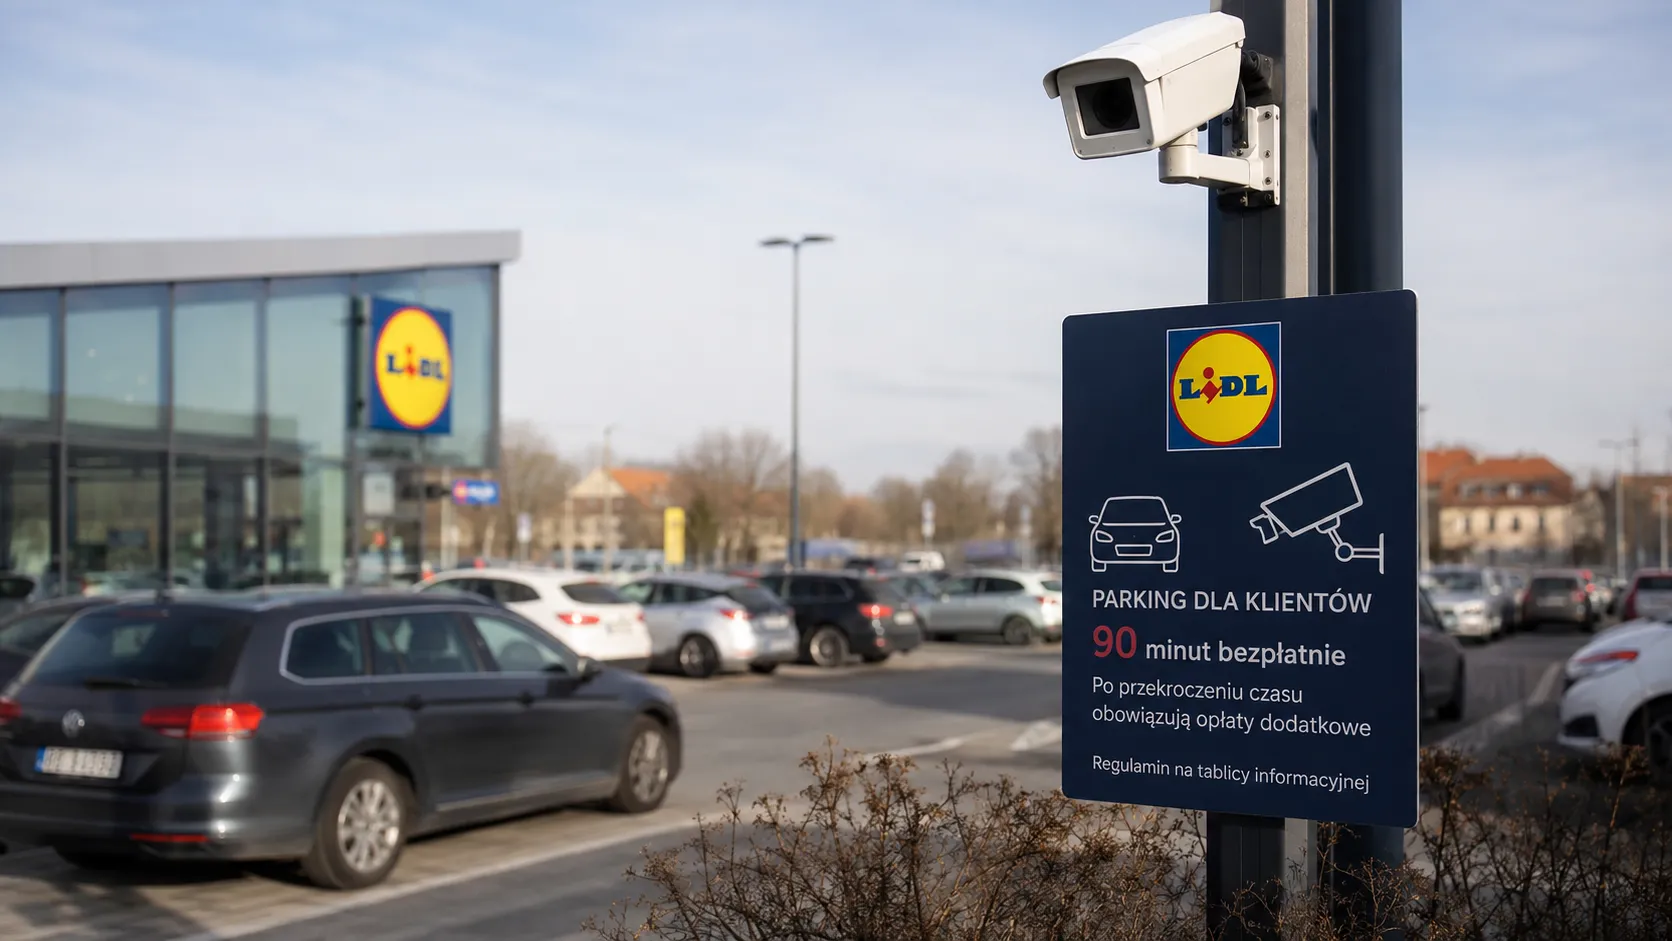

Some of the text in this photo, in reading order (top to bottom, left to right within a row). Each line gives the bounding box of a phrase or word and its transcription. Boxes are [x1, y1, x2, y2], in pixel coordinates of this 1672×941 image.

[1093, 588, 1372, 613] PARKING DLA KLIENTÓW
[1093, 625, 1345, 668] 90 minut bezpłatnie
[1093, 677, 1302, 703] Po przekroczeniu czasu
[1093, 705, 1371, 736] obowiązują opłaty dodatkowe
[1093, 755, 1369, 794] Regulamin na tablicy informacyjnej
